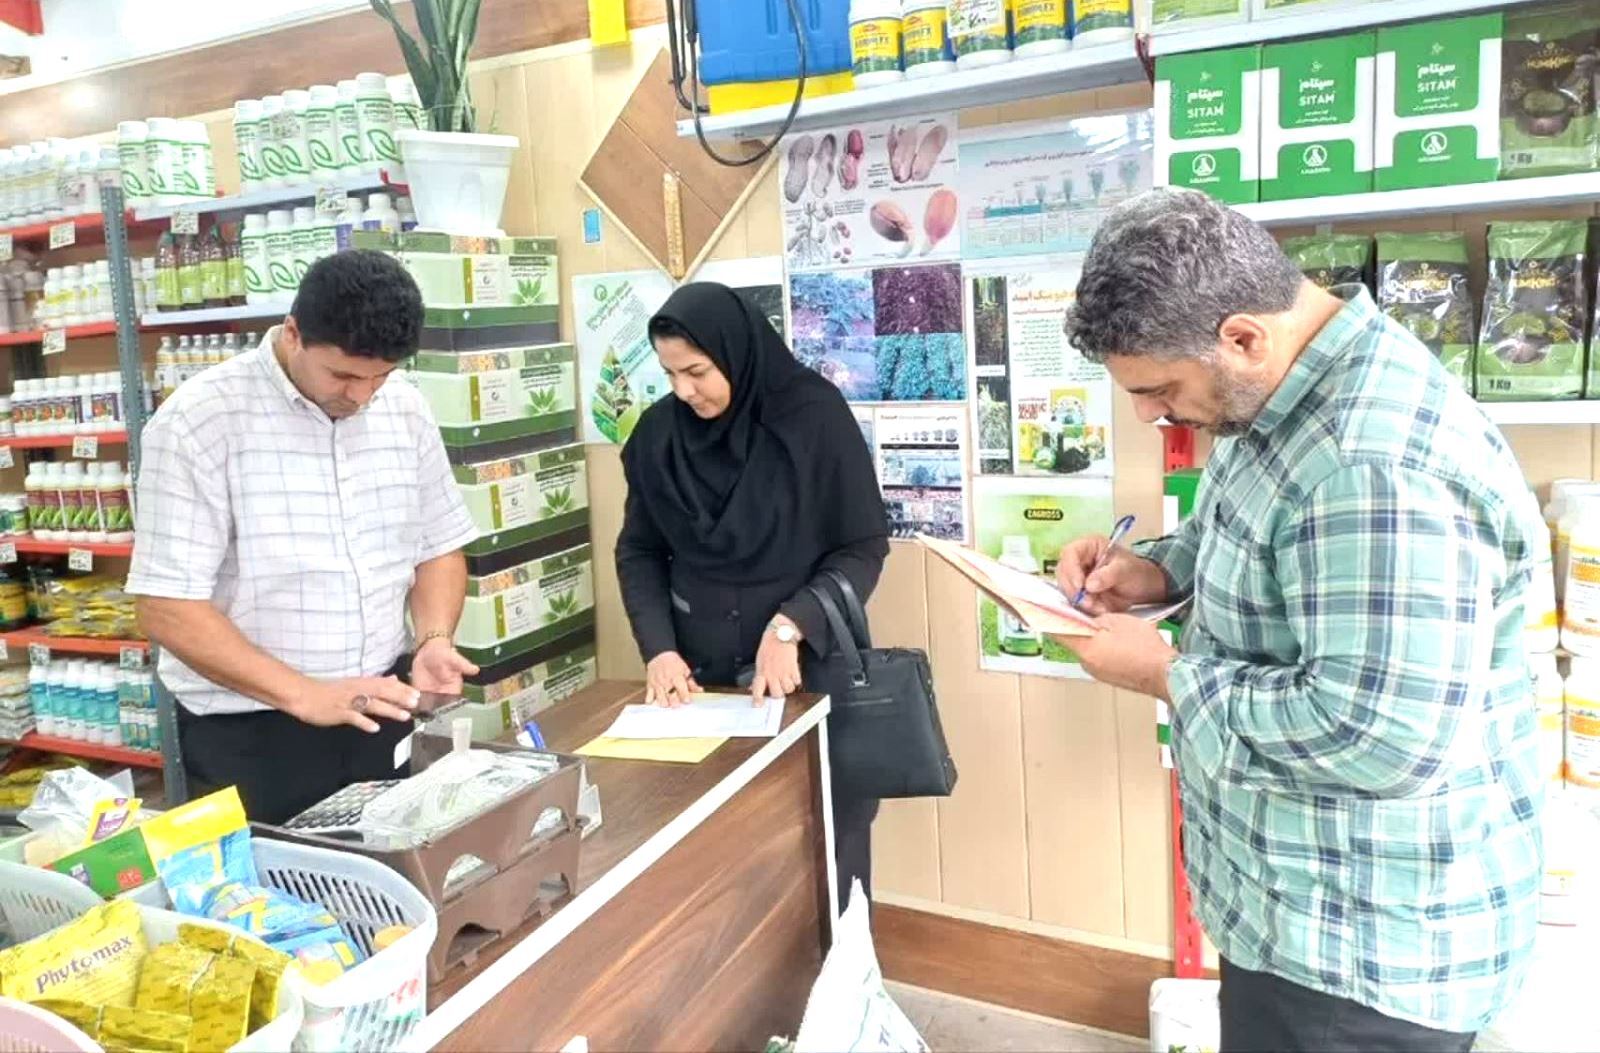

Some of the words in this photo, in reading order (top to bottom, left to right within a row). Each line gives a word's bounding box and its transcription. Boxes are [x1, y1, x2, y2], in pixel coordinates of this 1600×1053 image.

[1417, 79, 1456, 93] SITAM
[1299, 93, 1335, 106] SITAM
[1187, 105, 1223, 118] SITAM
[36, 934, 133, 994] Phytomax
